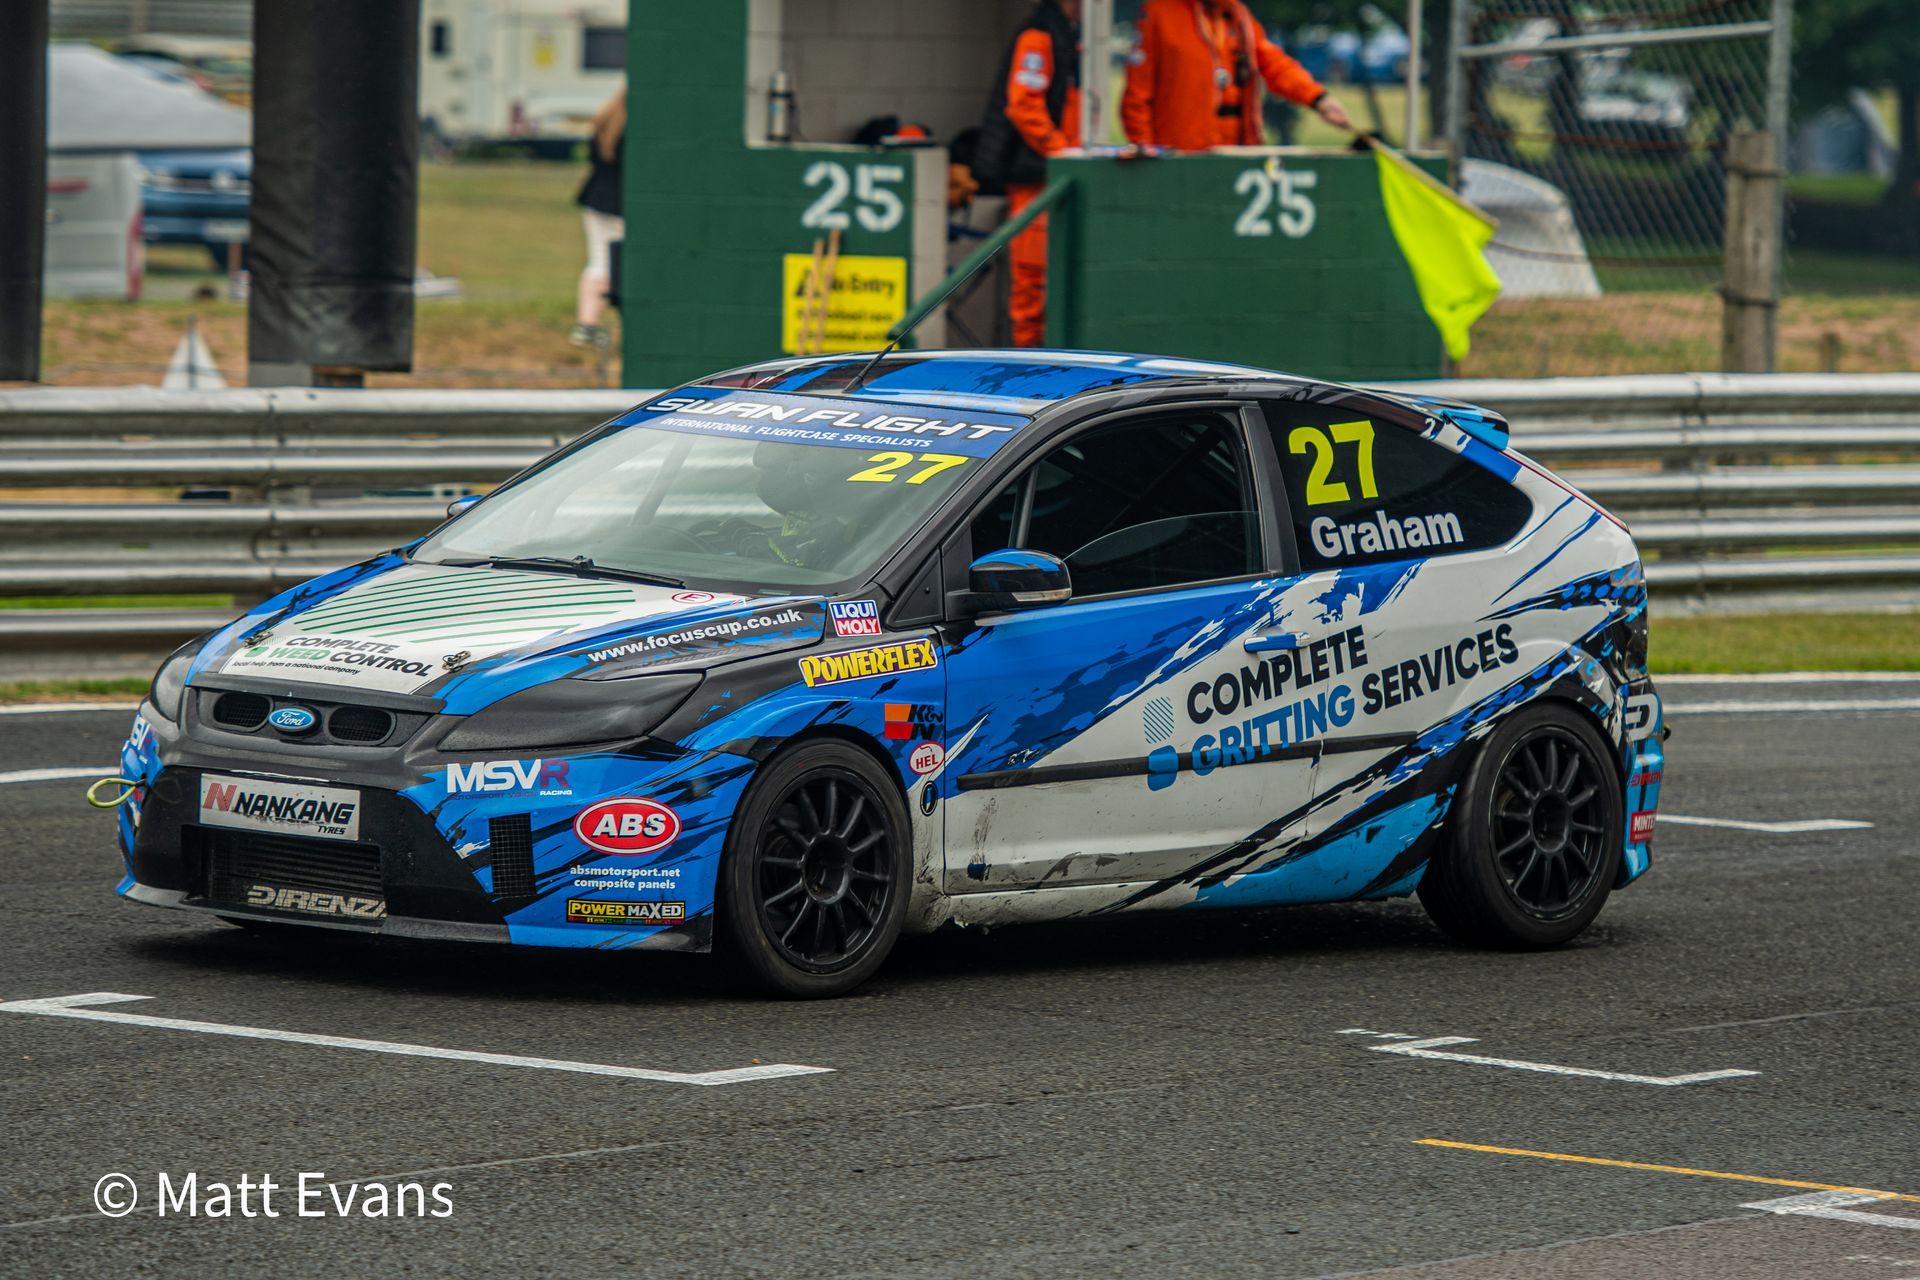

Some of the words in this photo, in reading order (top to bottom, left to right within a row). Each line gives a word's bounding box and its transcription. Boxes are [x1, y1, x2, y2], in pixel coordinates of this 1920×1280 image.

[802, 161, 904, 232] 25
[1233, 168, 1317, 238] 25
[646, 397, 804, 421] SWAN
[797, 409, 1013, 440] FLIGHT
[660, 416, 753, 433] INTERNATIONAL
[755, 425, 840, 441] FLIGHTCASE
[840, 433, 933, 447] SPECIALISTS
[847, 451, 969, 485] 27
[1288, 420, 1379, 506] 27
[1311, 510, 1464, 558] Graham
[832, 602, 875, 619] LIQUI
[587, 609, 803, 663] www.focuscup.co.uk
[838, 619, 879, 635] MOLY
[286, 637, 400, 654] COMPLETE
[267, 647, 331, 661] WEED
[330, 651, 433, 677] CONTROL
[291, 662, 325, 670] national
[323, 664, 361, 675] company
[801, 640, 936, 688] POWERFLEX
[1187, 625, 1368, 725] COMPLETE
[1191, 684, 1355, 776] GRITTING
[1362, 623, 1519, 715] SERVICES
[276, 711, 306, 726] Ford
[447, 759, 572, 793] MSVR
[915, 754, 939, 769] HEL
[232, 792, 355, 825] NANKANG
[317, 825, 347, 835] TYRES
[592, 813, 667, 837] ABS
[570, 865, 680, 879] absmotorsport.net
[574, 878, 635, 890] composite
[638, 879, 676, 891] panels
[571, 902, 626, 916] POWER
[627, 902, 682, 919] MAXED
